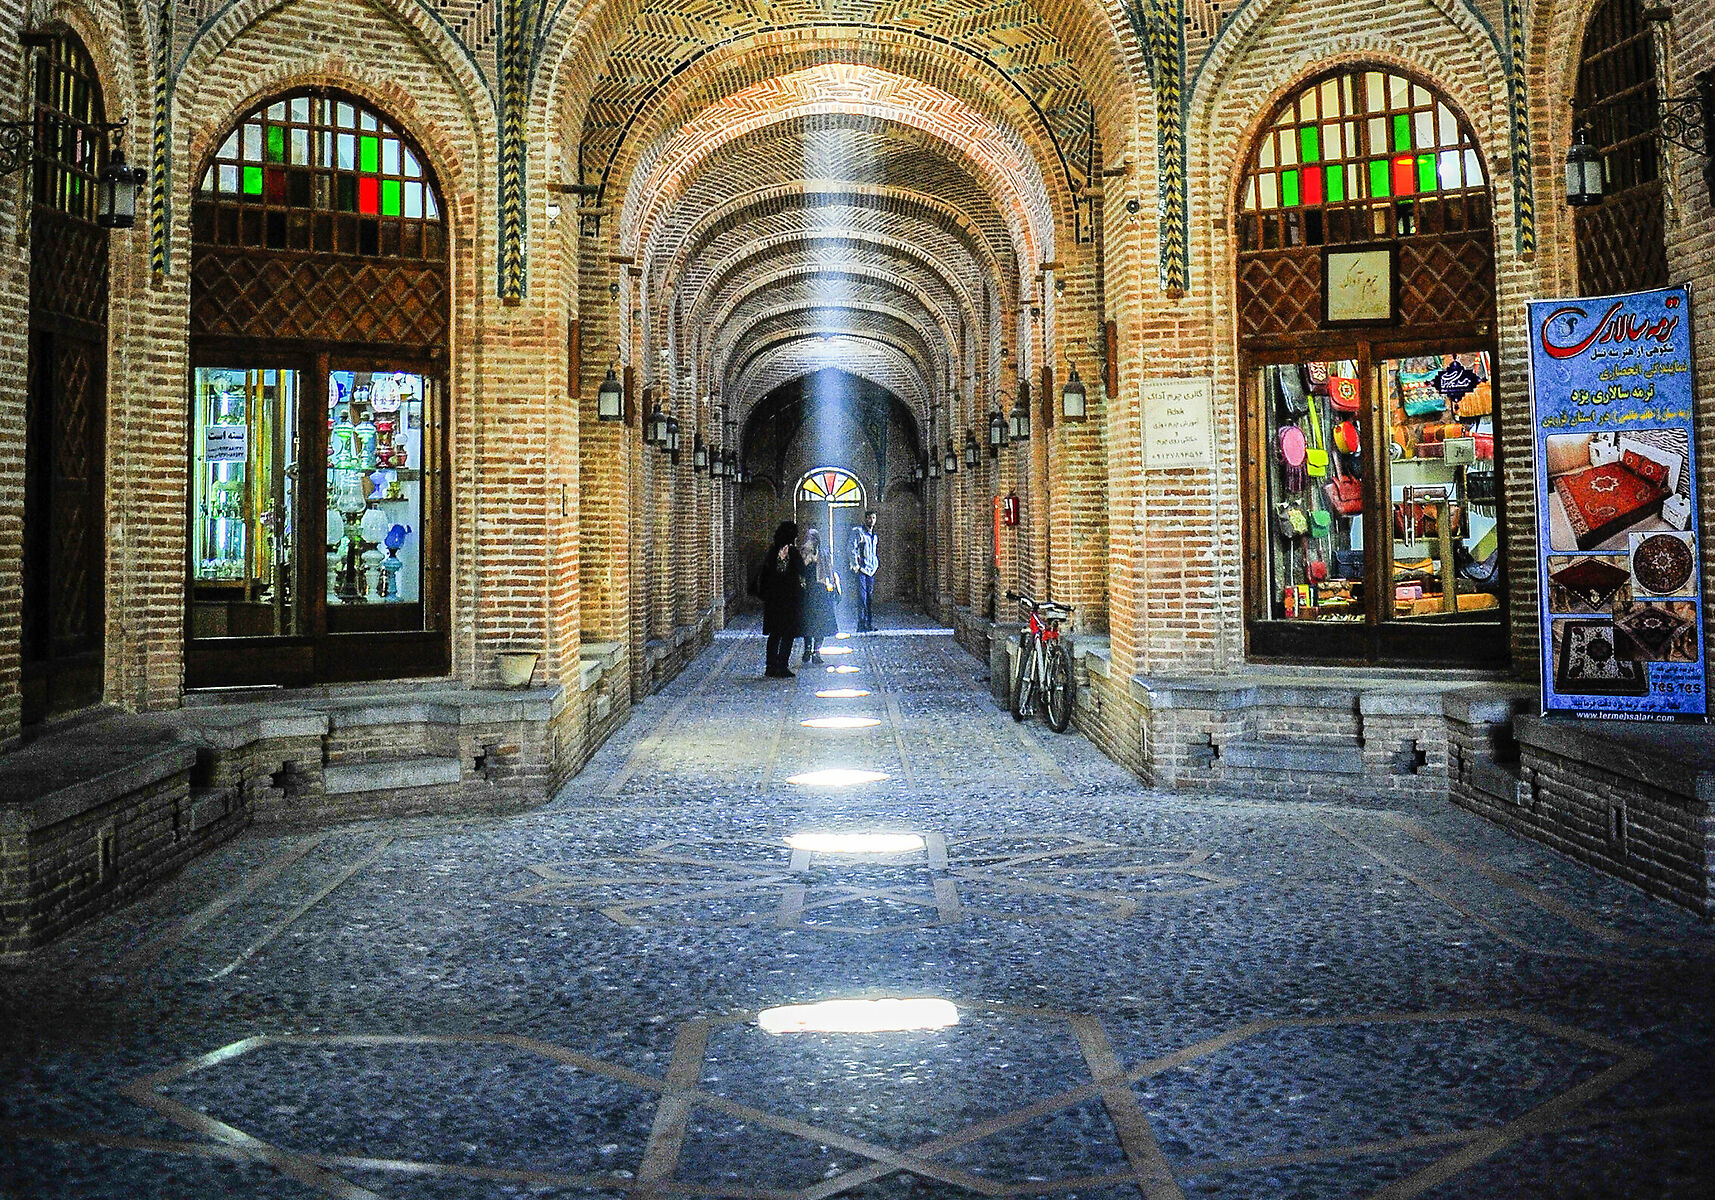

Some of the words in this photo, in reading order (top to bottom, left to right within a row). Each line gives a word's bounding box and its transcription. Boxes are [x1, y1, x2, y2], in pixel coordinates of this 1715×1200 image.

[1636, 345, 1644, 358] از
[1570, 388, 1590, 406] یزد
[1592, 384, 1630, 405] سالاری
[1631, 382, 1655, 403] ترمه
[208, 431, 226, 440] است
[228, 432, 244, 442] بسته
